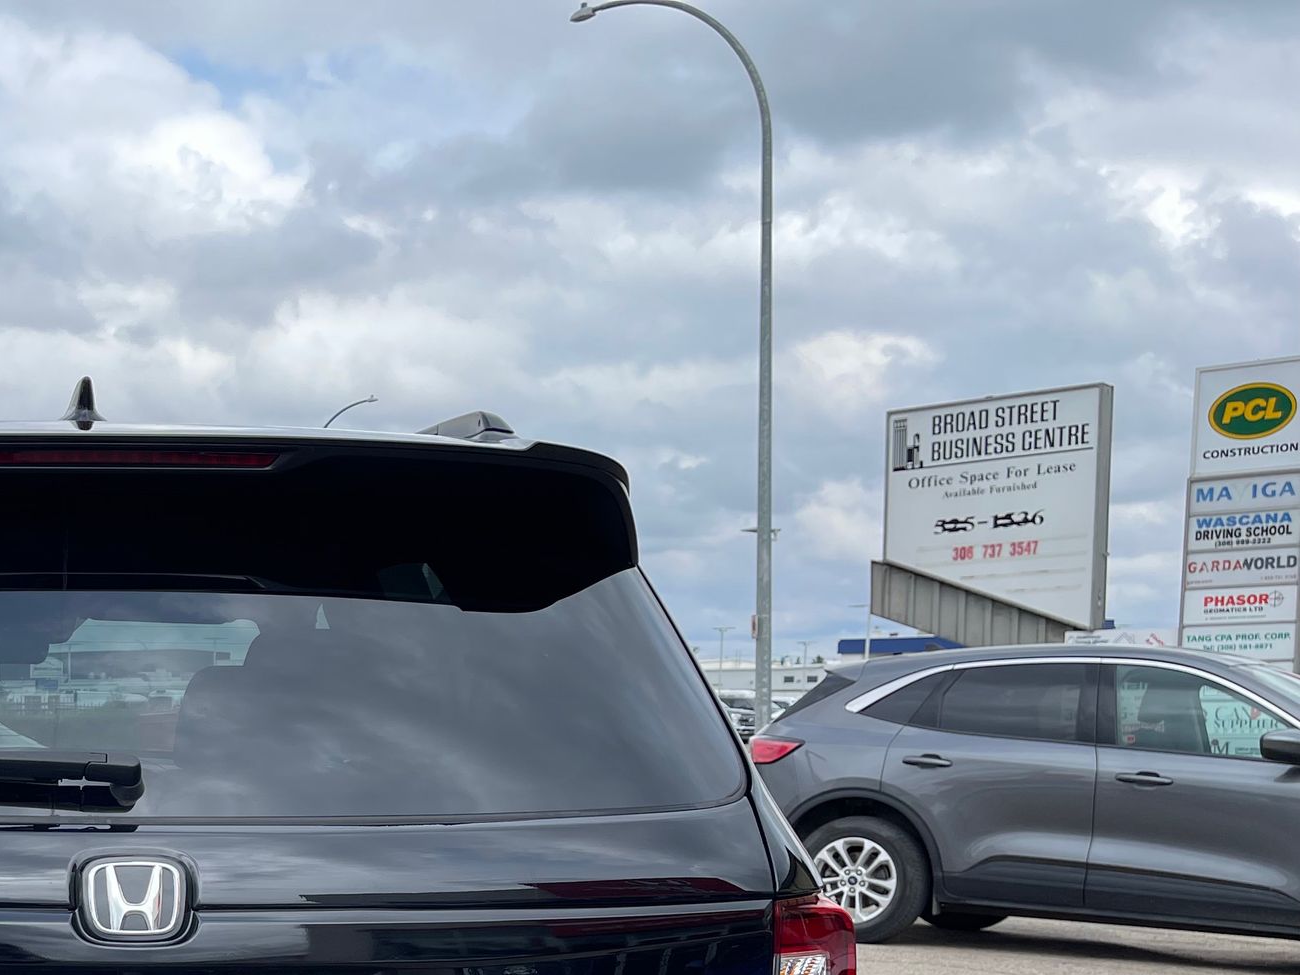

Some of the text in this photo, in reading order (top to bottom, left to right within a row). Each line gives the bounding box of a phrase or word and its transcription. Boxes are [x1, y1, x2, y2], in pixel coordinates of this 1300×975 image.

[932, 400, 1059, 435] BROAD STREET
[1221, 396, 1282, 425] PCL
[931, 423, 1089, 462] BUSINESS CENTRE
[1202, 442, 1299, 460] CONSTRUCTION
[908, 462, 1077, 489] Office Space For Lease
[943, 481, 1038, 499] Available Furnished
[1196, 511, 1292, 529] WASCANA
[1194, 524, 1293, 541] DRIVING SCHOOL
[982, 543, 1003, 559] 737
[1009, 540, 1040, 557] 3547
[1187, 555, 1298, 574] GARDAWORLD
[1203, 593, 1269, 607] PHASOR
[1186, 634, 1212, 643] TANG
[1214, 633, 1233, 641] CPA
